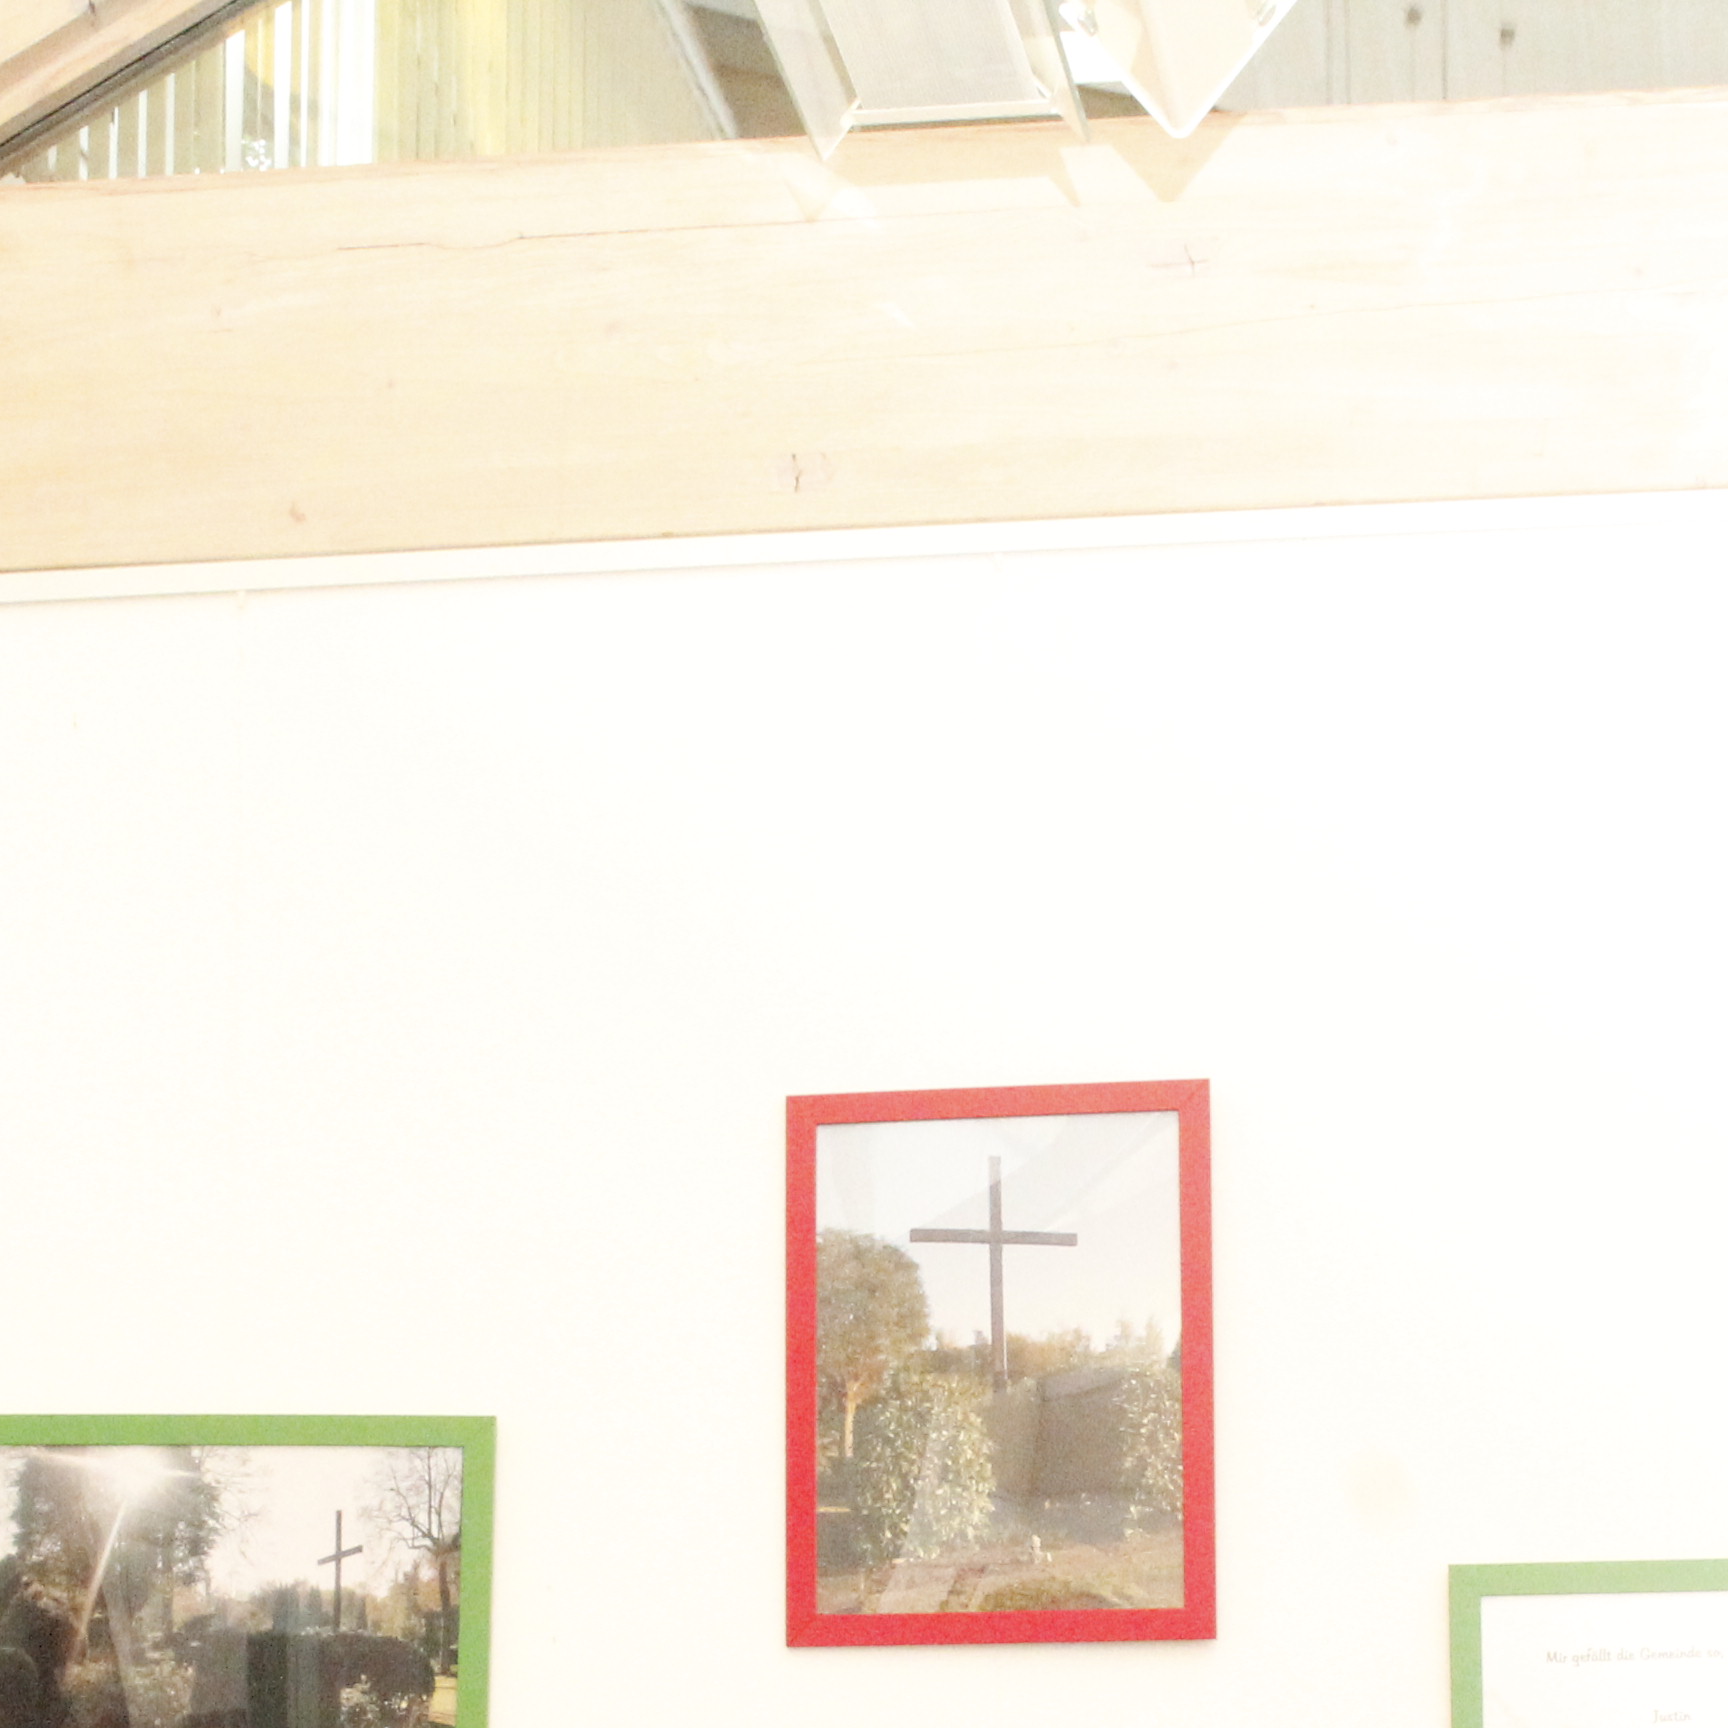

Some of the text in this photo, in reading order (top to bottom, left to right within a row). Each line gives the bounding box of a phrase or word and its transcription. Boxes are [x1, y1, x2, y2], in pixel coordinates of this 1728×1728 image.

[1545, 1650, 1568, 1665] Mir
[1571, 1647, 1612, 1667] gefällt
[1616, 1647, 1636, 1662] die
[1639, 1645, 1703, 1662] Gemeinde
[1652, 1708, 1692, 1724] Justin
